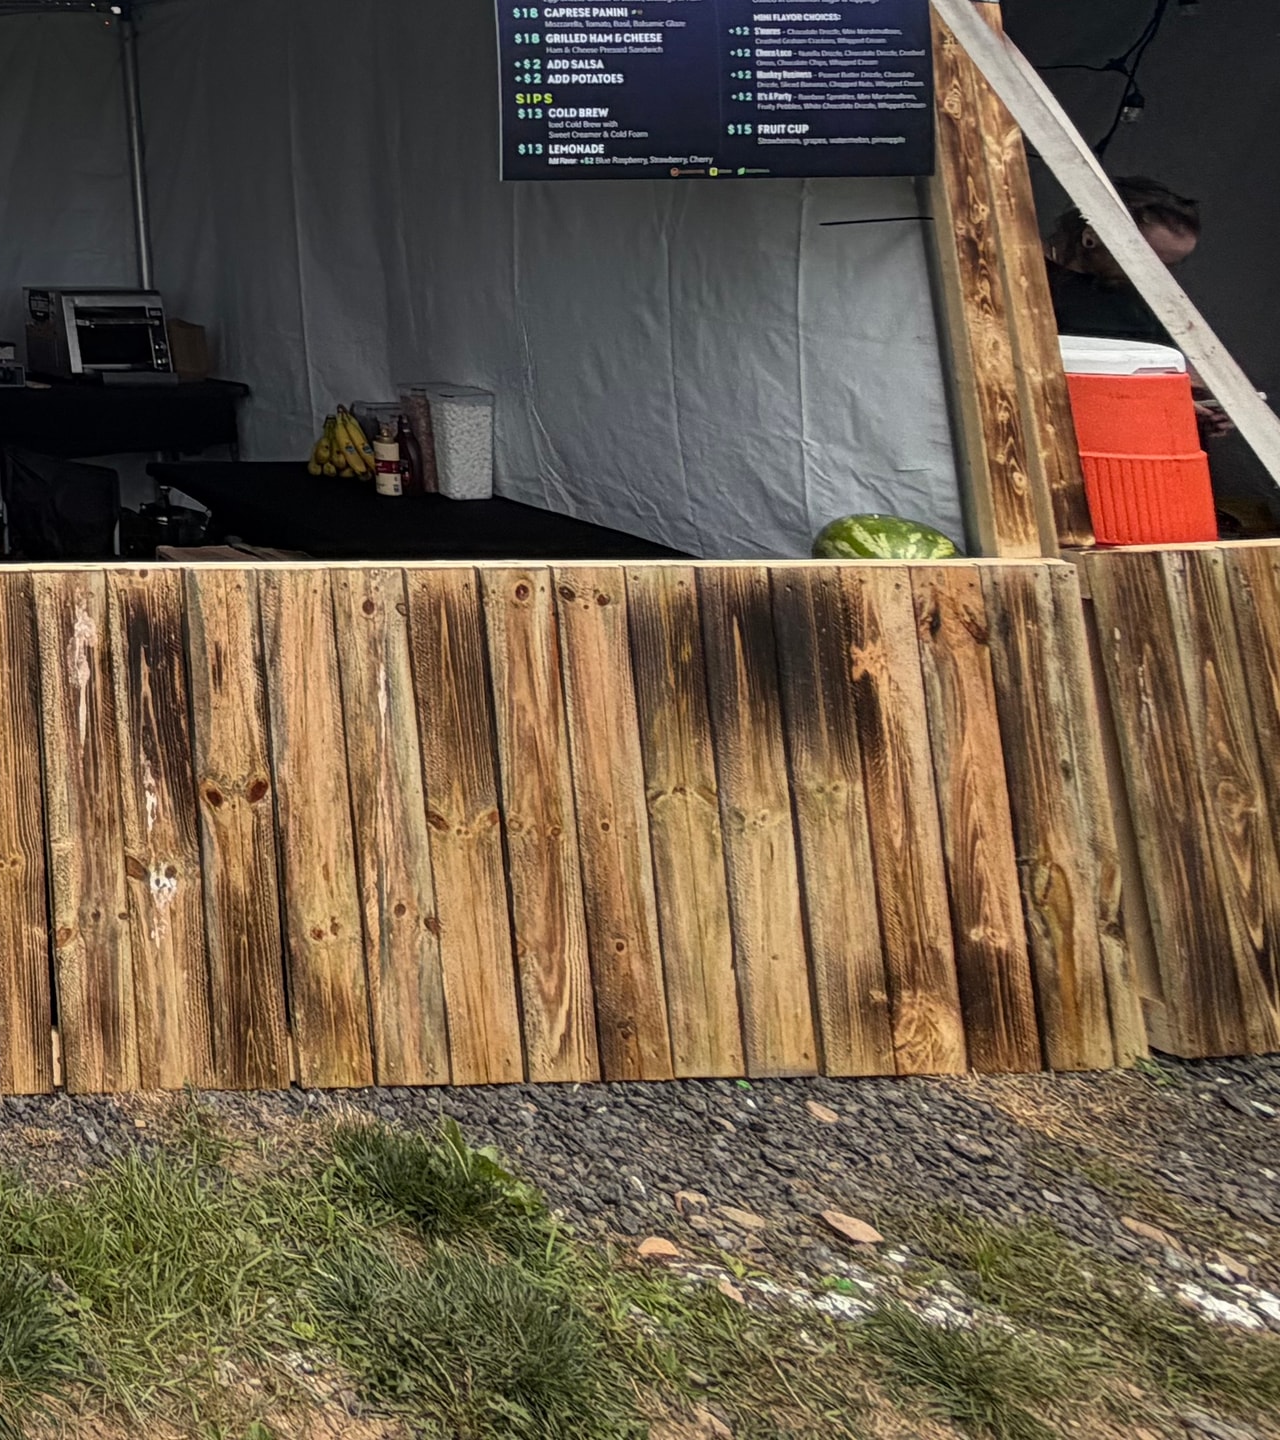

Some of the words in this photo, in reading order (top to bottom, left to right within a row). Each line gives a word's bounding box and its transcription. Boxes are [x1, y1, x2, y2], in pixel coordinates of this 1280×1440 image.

[513, 7, 539, 19] $18
[544, 7, 591, 18] CAPRESE
[592, 7, 628, 18] PANINI
[514, 33, 540, 44] $18
[545, 33, 588, 43] GRILLED
[589, 33, 614, 43] HAM
[623, 33, 663, 43] CHEESE
[546, 59, 570, 70] ADD
[571, 59, 605, 70] SALSA
[547, 74, 570, 84] ADD
[571, 74, 624, 84] POTATOES
[515, 93, 553, 104] SIPS
[517, 108, 543, 119] $13
[548, 108, 578, 118] COLD
[578, 108, 609, 118] BREW
[727, 124, 752, 135] $15
[757, 124, 786, 134] FRUIT
[786, 124, 810, 134] CUP
[518, 143, 543, 155] $13
[548, 144, 605, 154] LEMONADE
